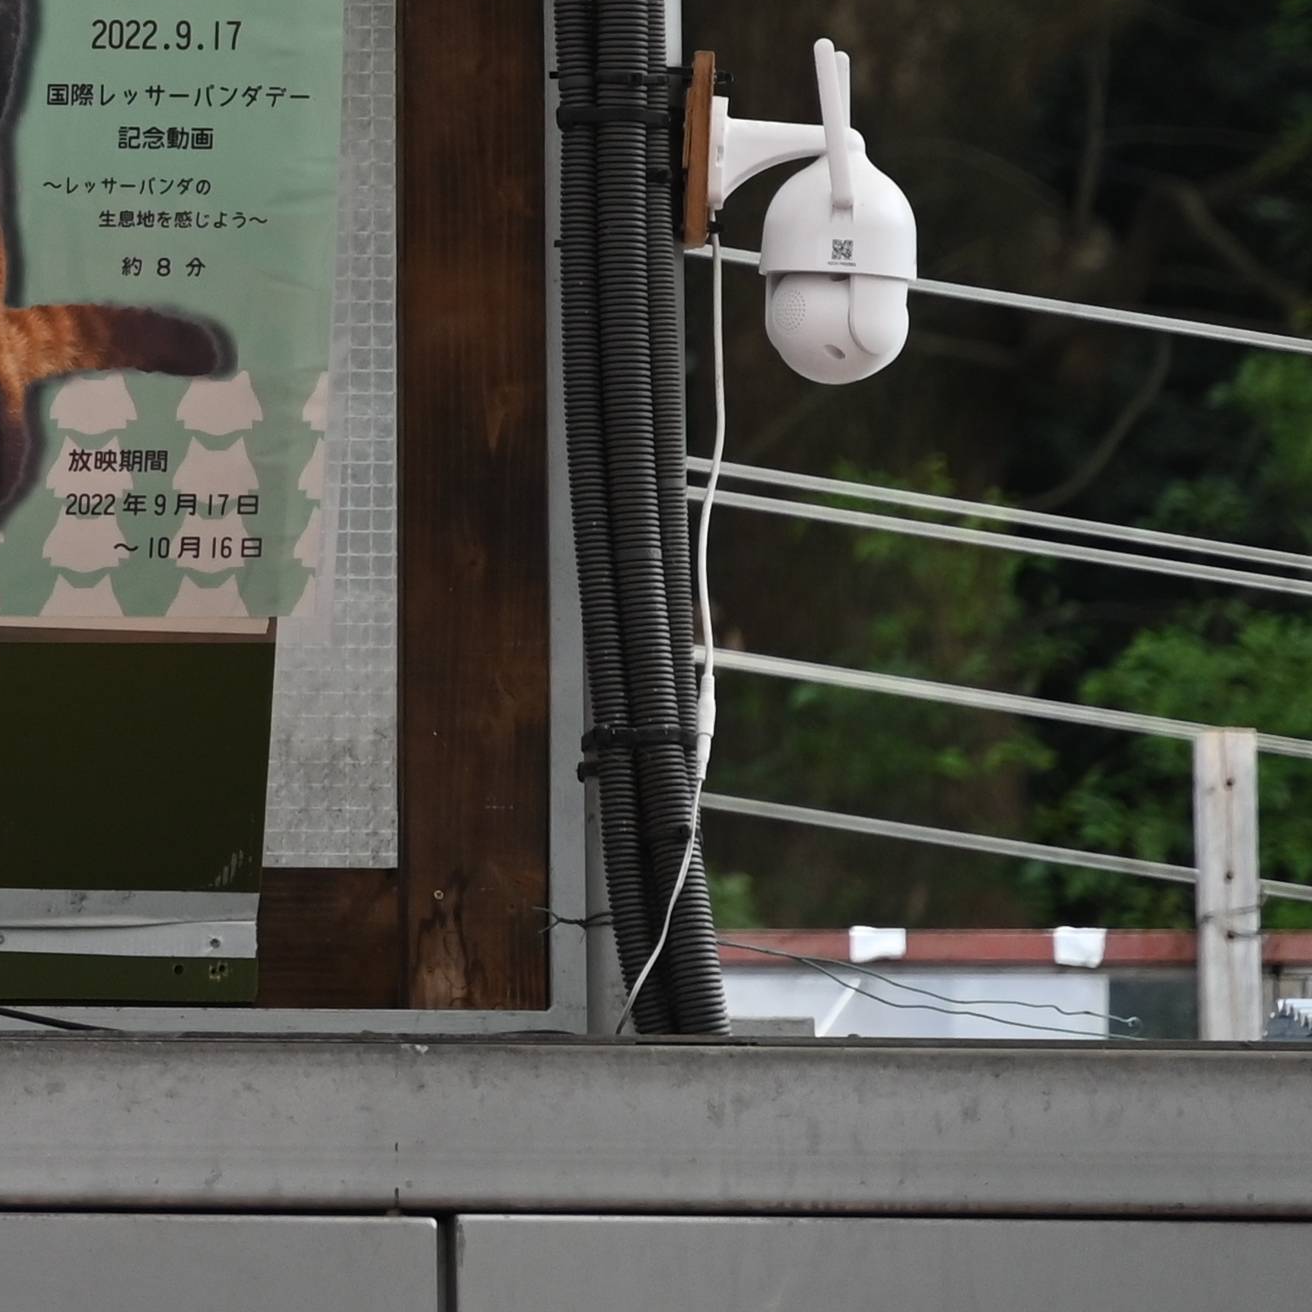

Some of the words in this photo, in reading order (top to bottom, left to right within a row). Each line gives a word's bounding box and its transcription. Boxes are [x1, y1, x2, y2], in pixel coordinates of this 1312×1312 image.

[91, 20, 242, 51] 2022.9.17
[46, 84, 311, 108] 国際レッサーパンダデー
[118, 127, 214, 150] 記念動画
[68, 449, 169, 473] 放映期間
